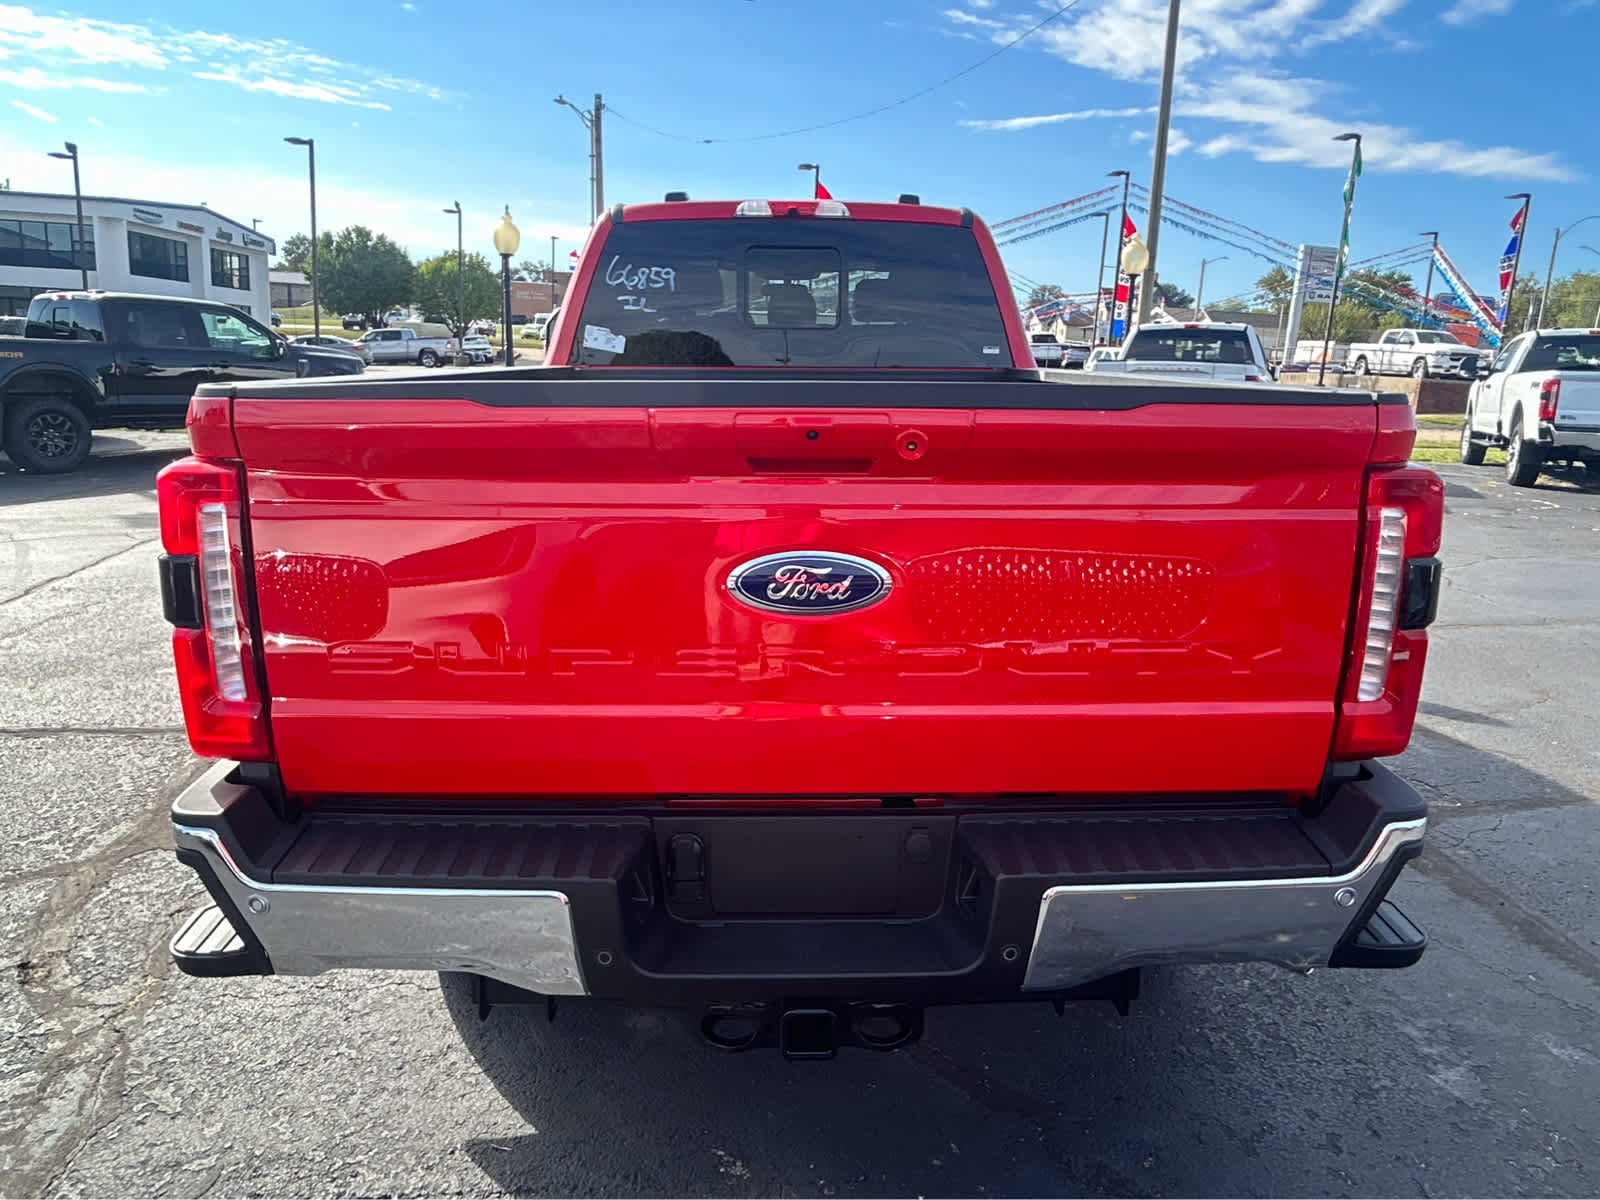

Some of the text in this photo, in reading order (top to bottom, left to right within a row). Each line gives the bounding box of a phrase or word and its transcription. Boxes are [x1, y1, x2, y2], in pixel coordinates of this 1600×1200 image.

[606, 255, 676, 292] 66859
[767, 565, 854, 600] Ford
[326, 639, 1283, 676] SUPER DUTY
